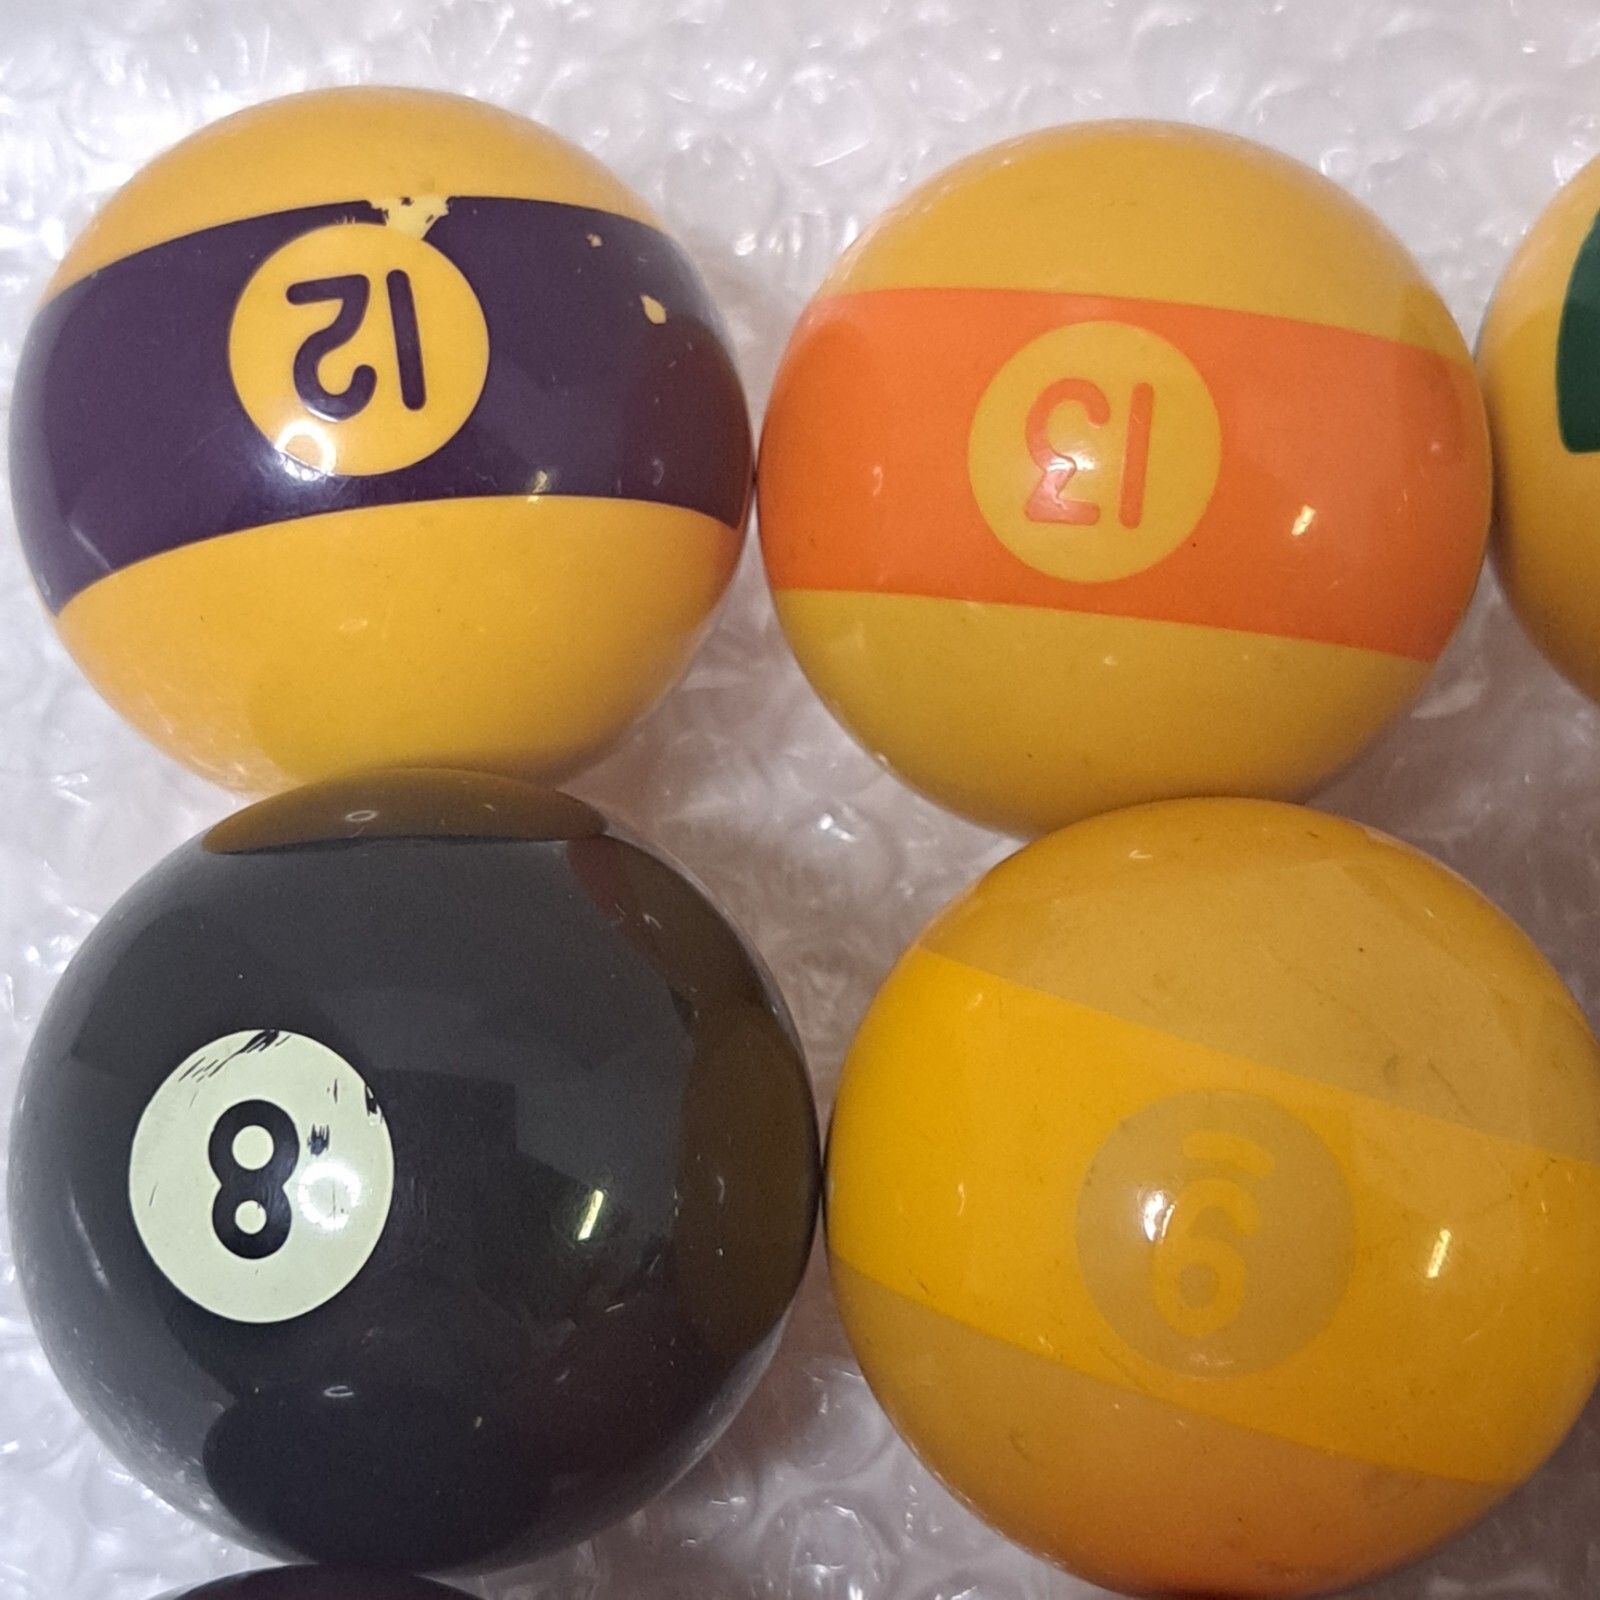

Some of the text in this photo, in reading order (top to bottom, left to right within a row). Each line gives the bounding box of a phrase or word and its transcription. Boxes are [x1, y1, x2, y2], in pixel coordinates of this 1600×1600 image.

[286, 269, 426, 421] 12
[1024, 378, 1154, 528] 13
[208, 1099, 300, 1259] 8
